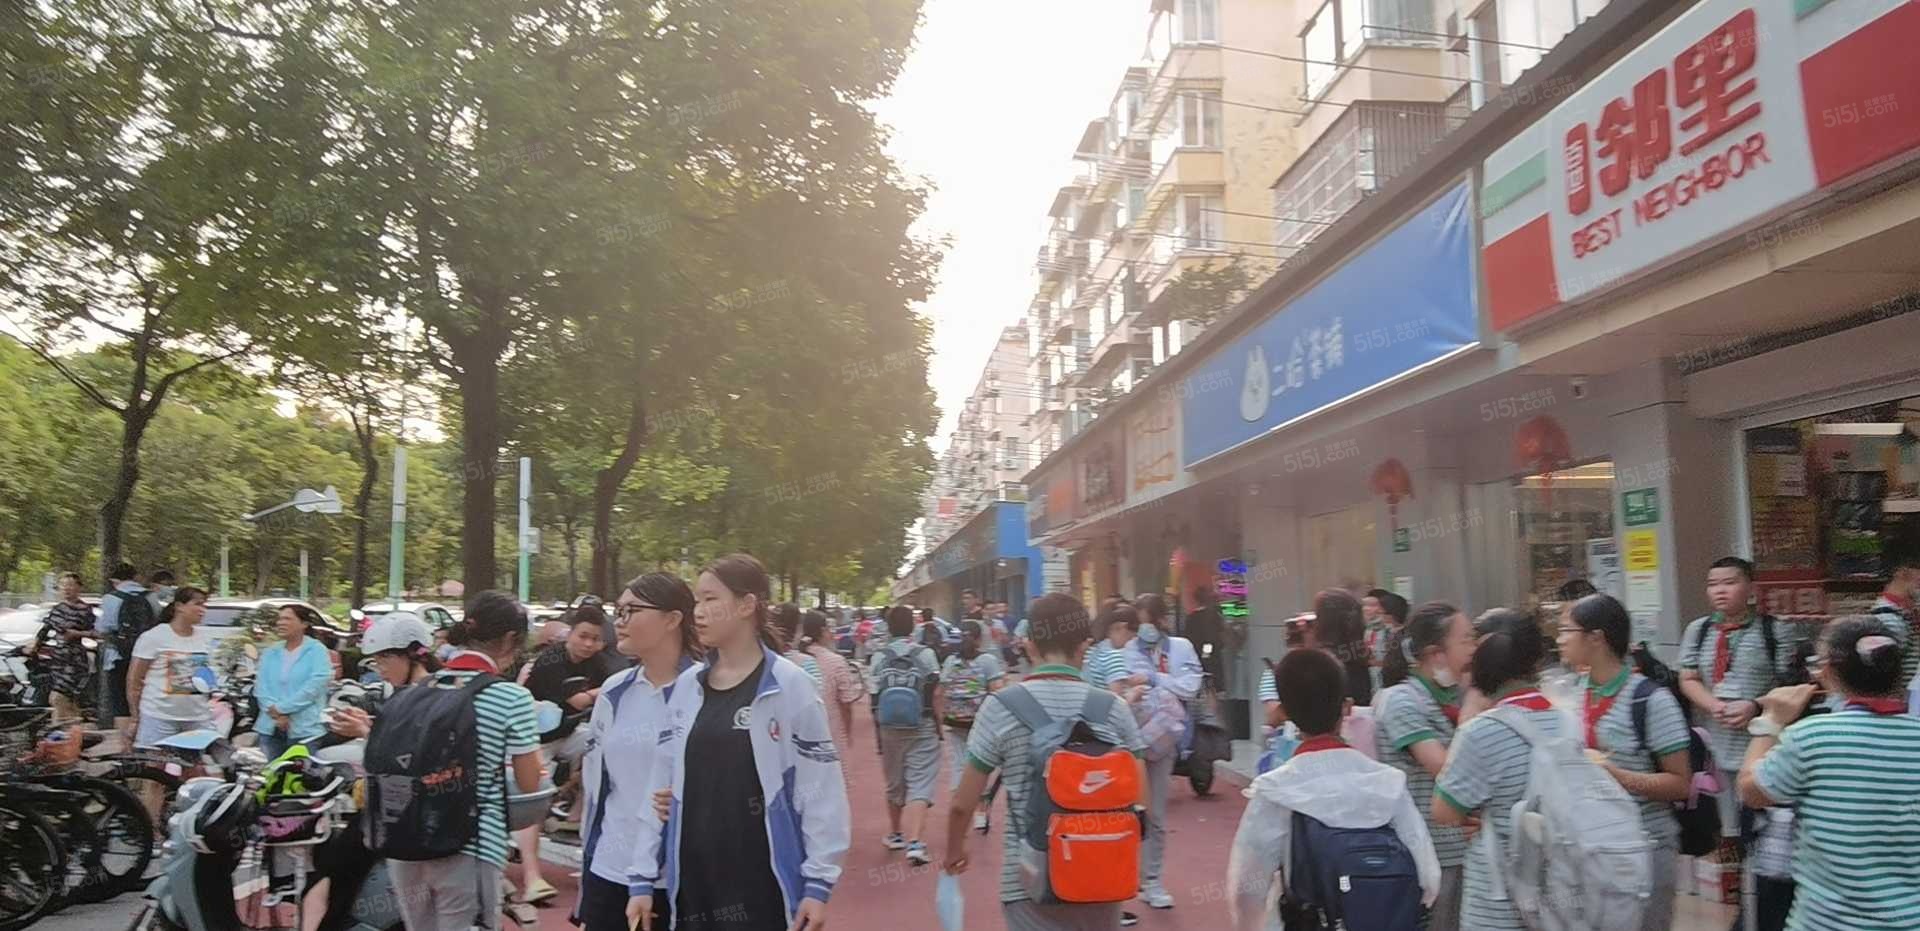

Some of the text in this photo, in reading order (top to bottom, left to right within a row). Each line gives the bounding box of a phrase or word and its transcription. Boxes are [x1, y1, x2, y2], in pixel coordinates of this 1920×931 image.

[1596, 7, 1762, 197] 邻里
[1570, 208, 1624, 258] BEST
[1633, 132, 1772, 228] NEIGHBOR
